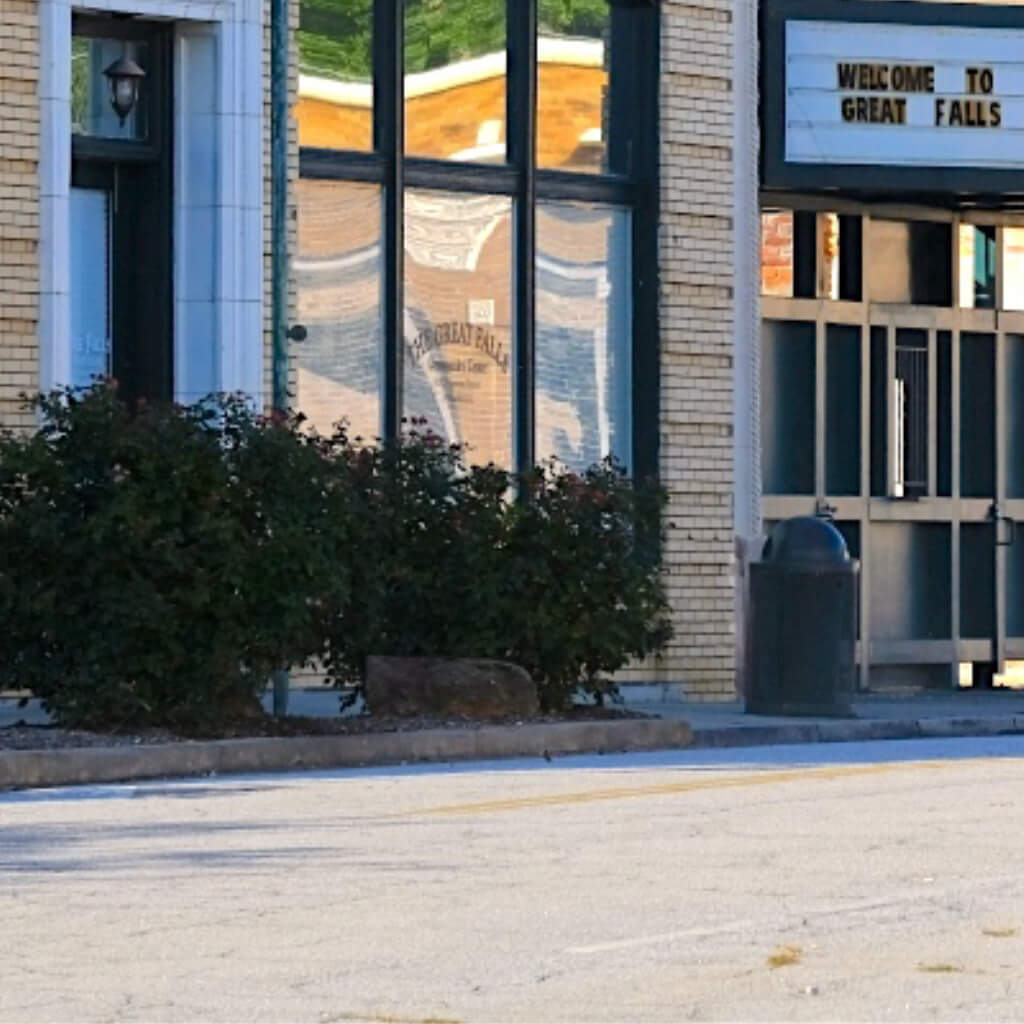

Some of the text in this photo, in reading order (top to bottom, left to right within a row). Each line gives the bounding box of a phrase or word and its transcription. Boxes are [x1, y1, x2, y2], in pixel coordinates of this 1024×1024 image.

[837, 63, 993, 94] WELCOME TO
[841, 98, 1001, 127] GREAT FALLS
[434, 321, 472, 347] GREAT
[475, 326, 510, 374] FALLS
